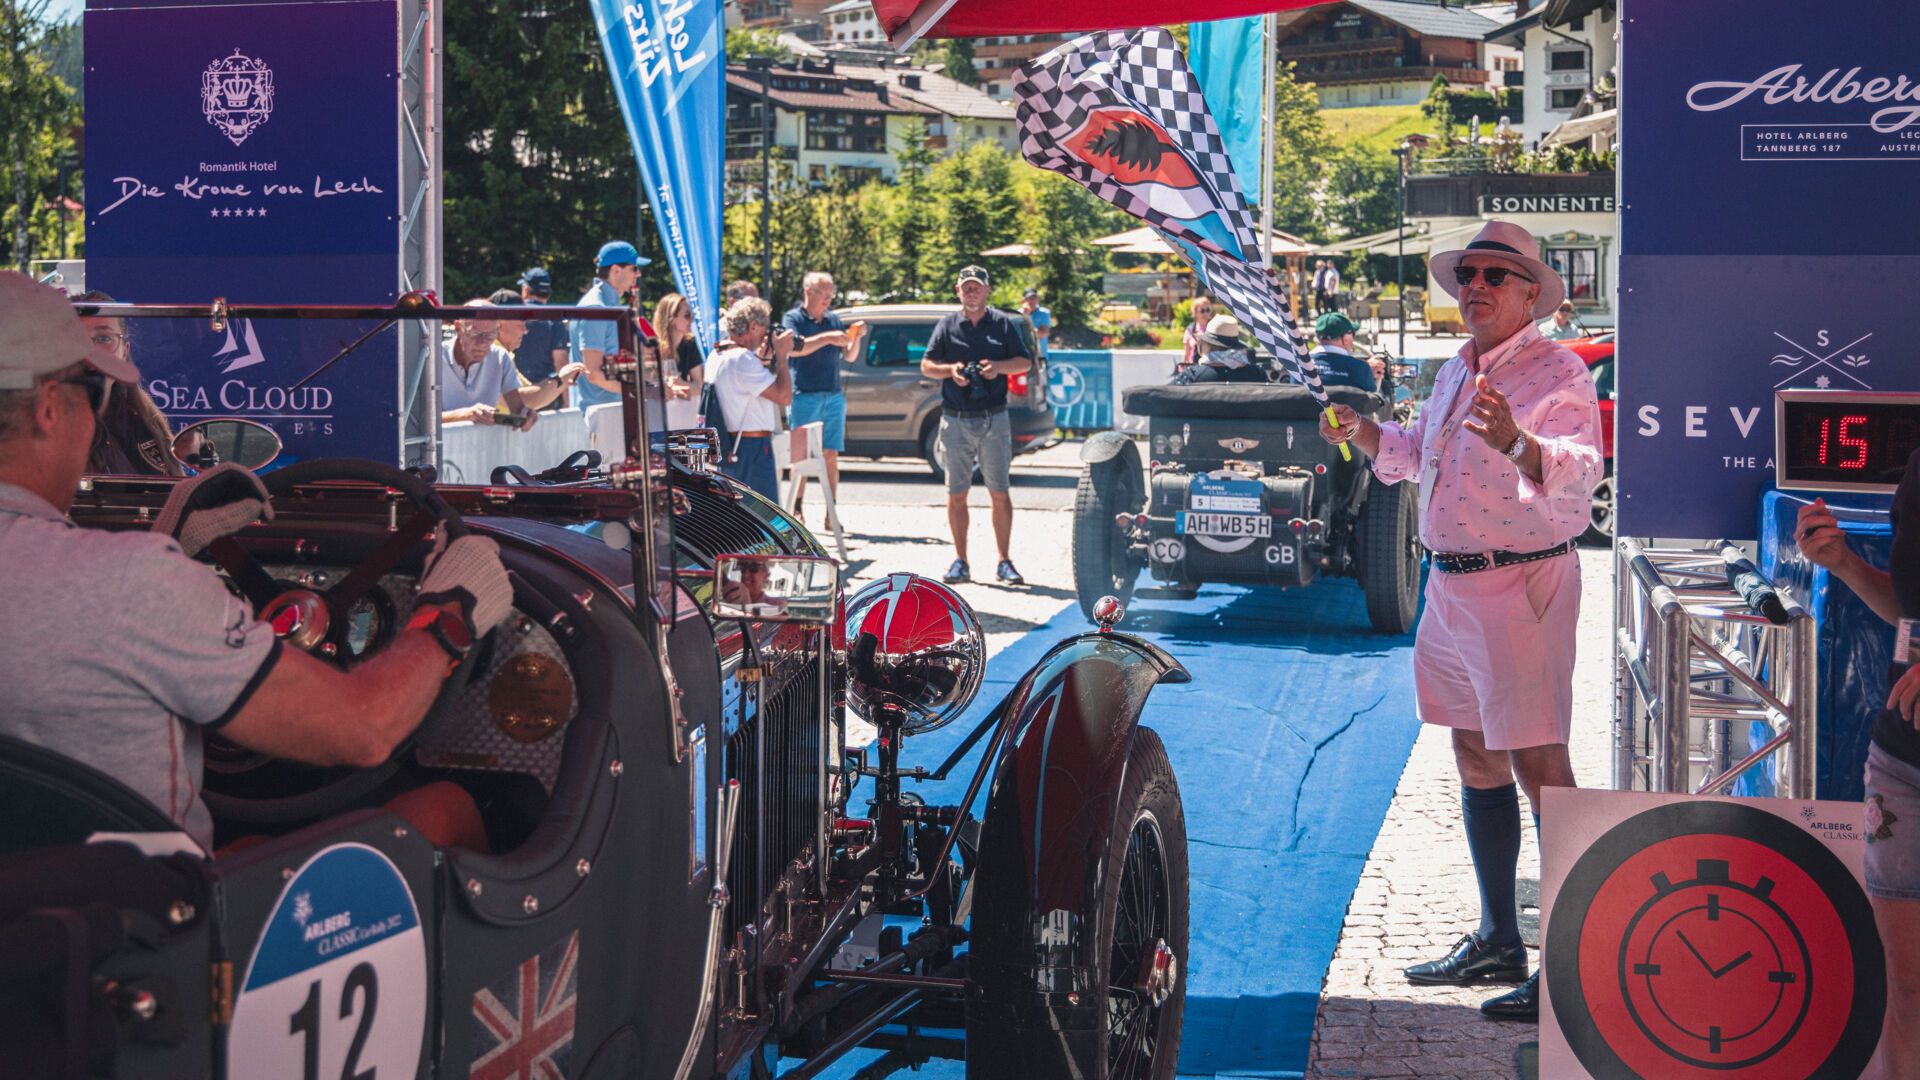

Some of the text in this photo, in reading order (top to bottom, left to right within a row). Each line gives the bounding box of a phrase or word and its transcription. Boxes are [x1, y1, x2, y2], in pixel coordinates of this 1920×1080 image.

[1756, 131, 1793, 140] HOTEL
[1797, 131, 1848, 140] ARLBERG
[1756, 144, 1817, 152] TANNBERG
[1822, 144, 1841, 152] 187
[199, 161, 277, 173] Romantik Hotel
[99, 175, 384, 216] Die Krone von Lech
[1491, 196, 1614, 213] SONNENTE
[1816, 329, 1830, 347] S
[1637, 404, 1761, 439] SEV
[1819, 415, 1868, 469] 15
[1723, 456, 1756, 469] THE
[1187, 514, 1209, 532] AH
[1265, 545, 1295, 565] GB
[1810, 822, 1853, 831] ARLBERG
[304, 911, 351, 941] ARLBERG
[289, 961, 379, 1080] 12
